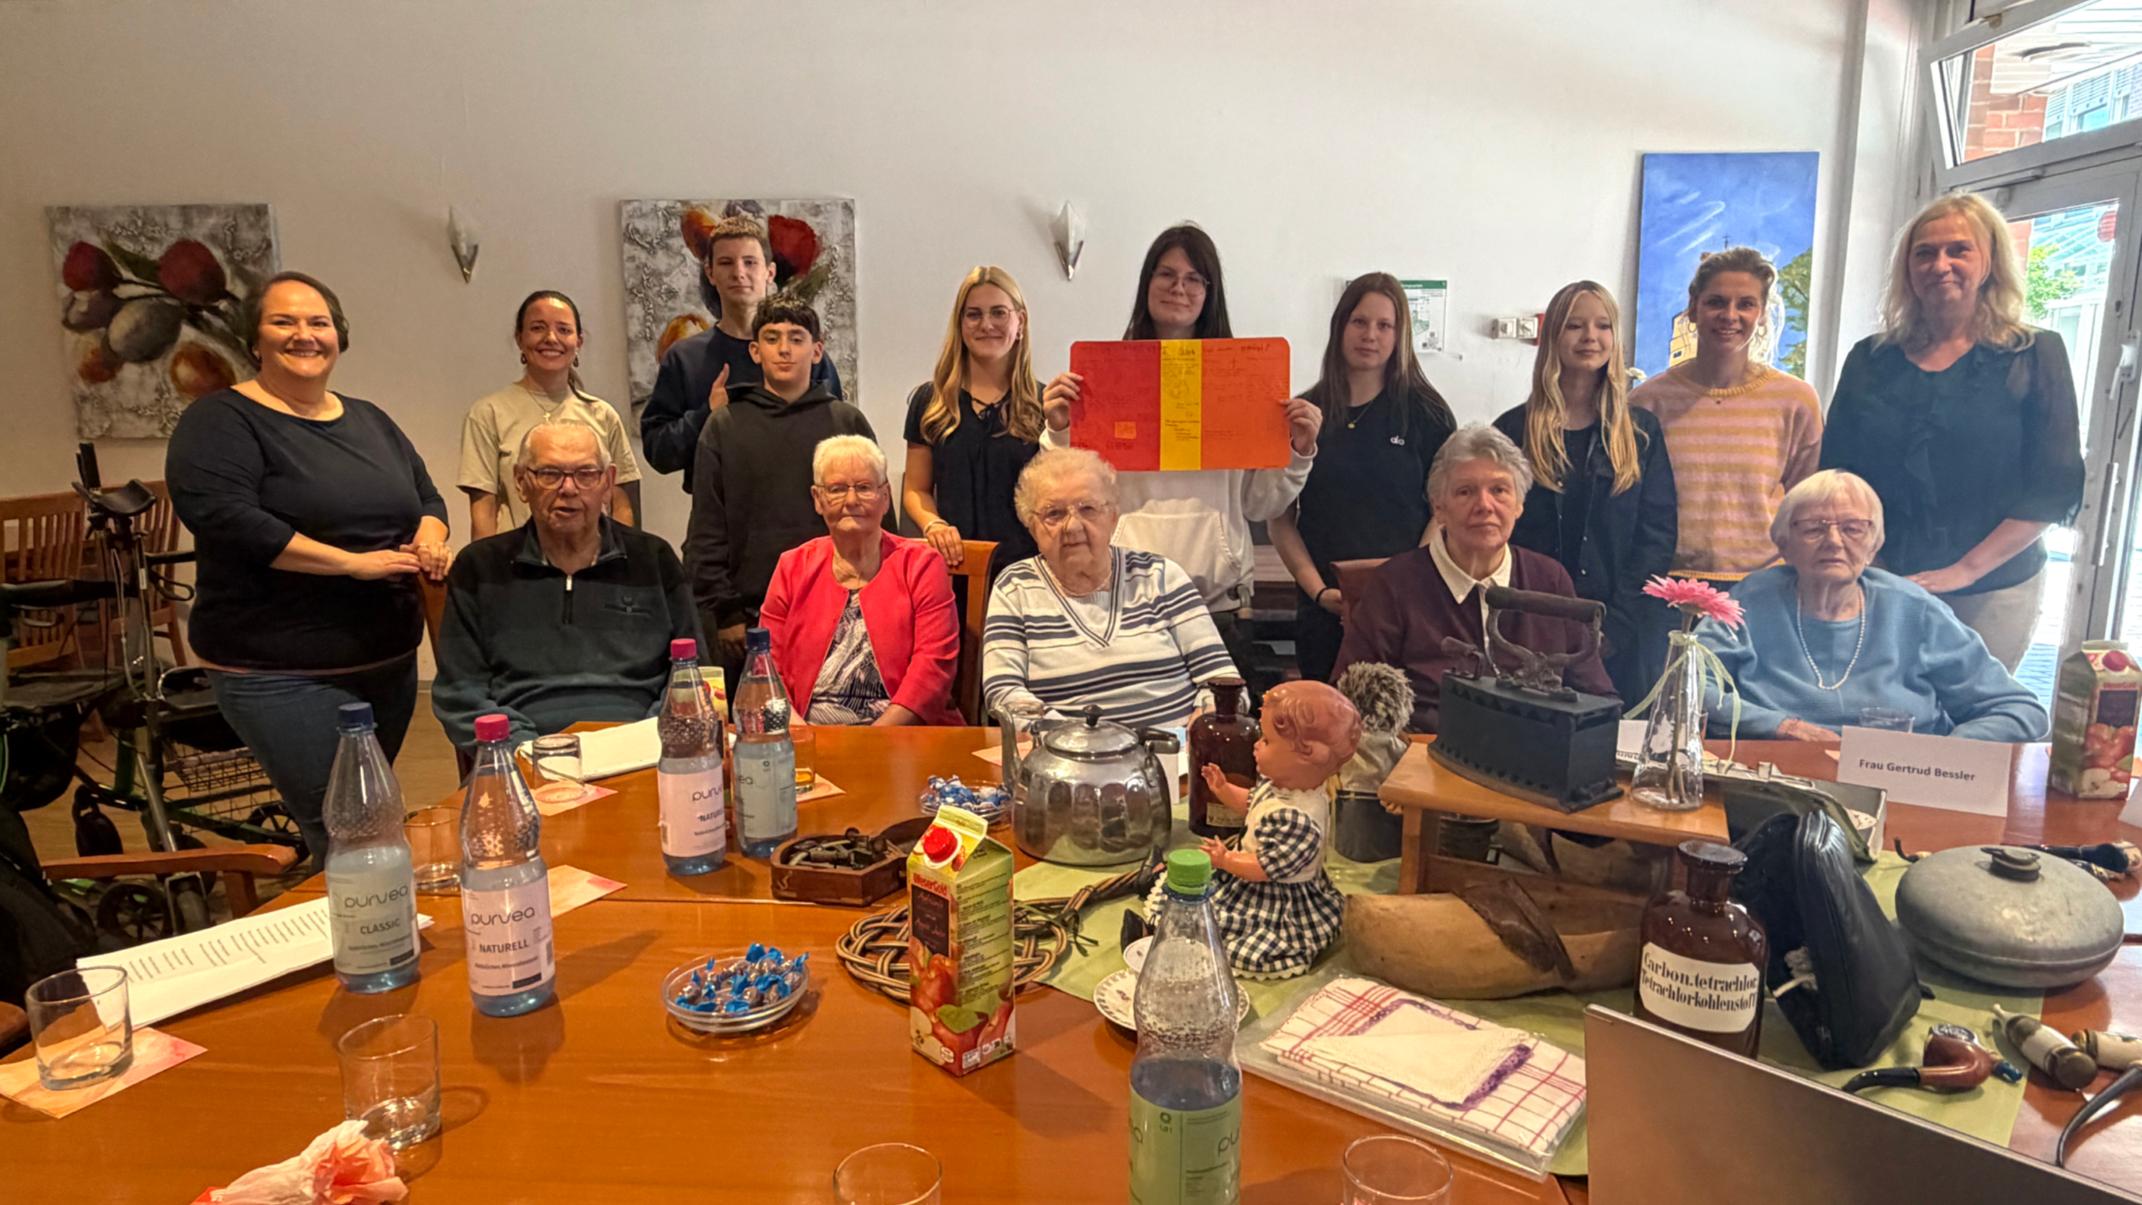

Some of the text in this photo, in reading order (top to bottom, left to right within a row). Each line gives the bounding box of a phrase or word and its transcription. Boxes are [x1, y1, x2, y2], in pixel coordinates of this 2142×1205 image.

[1859, 759, 1976, 780] Frau Gertrud Bessler
[471, 906, 536, 926] purvea
[359, 918, 401, 935] CLASSIC
[479, 939, 529, 953] NATURELL
